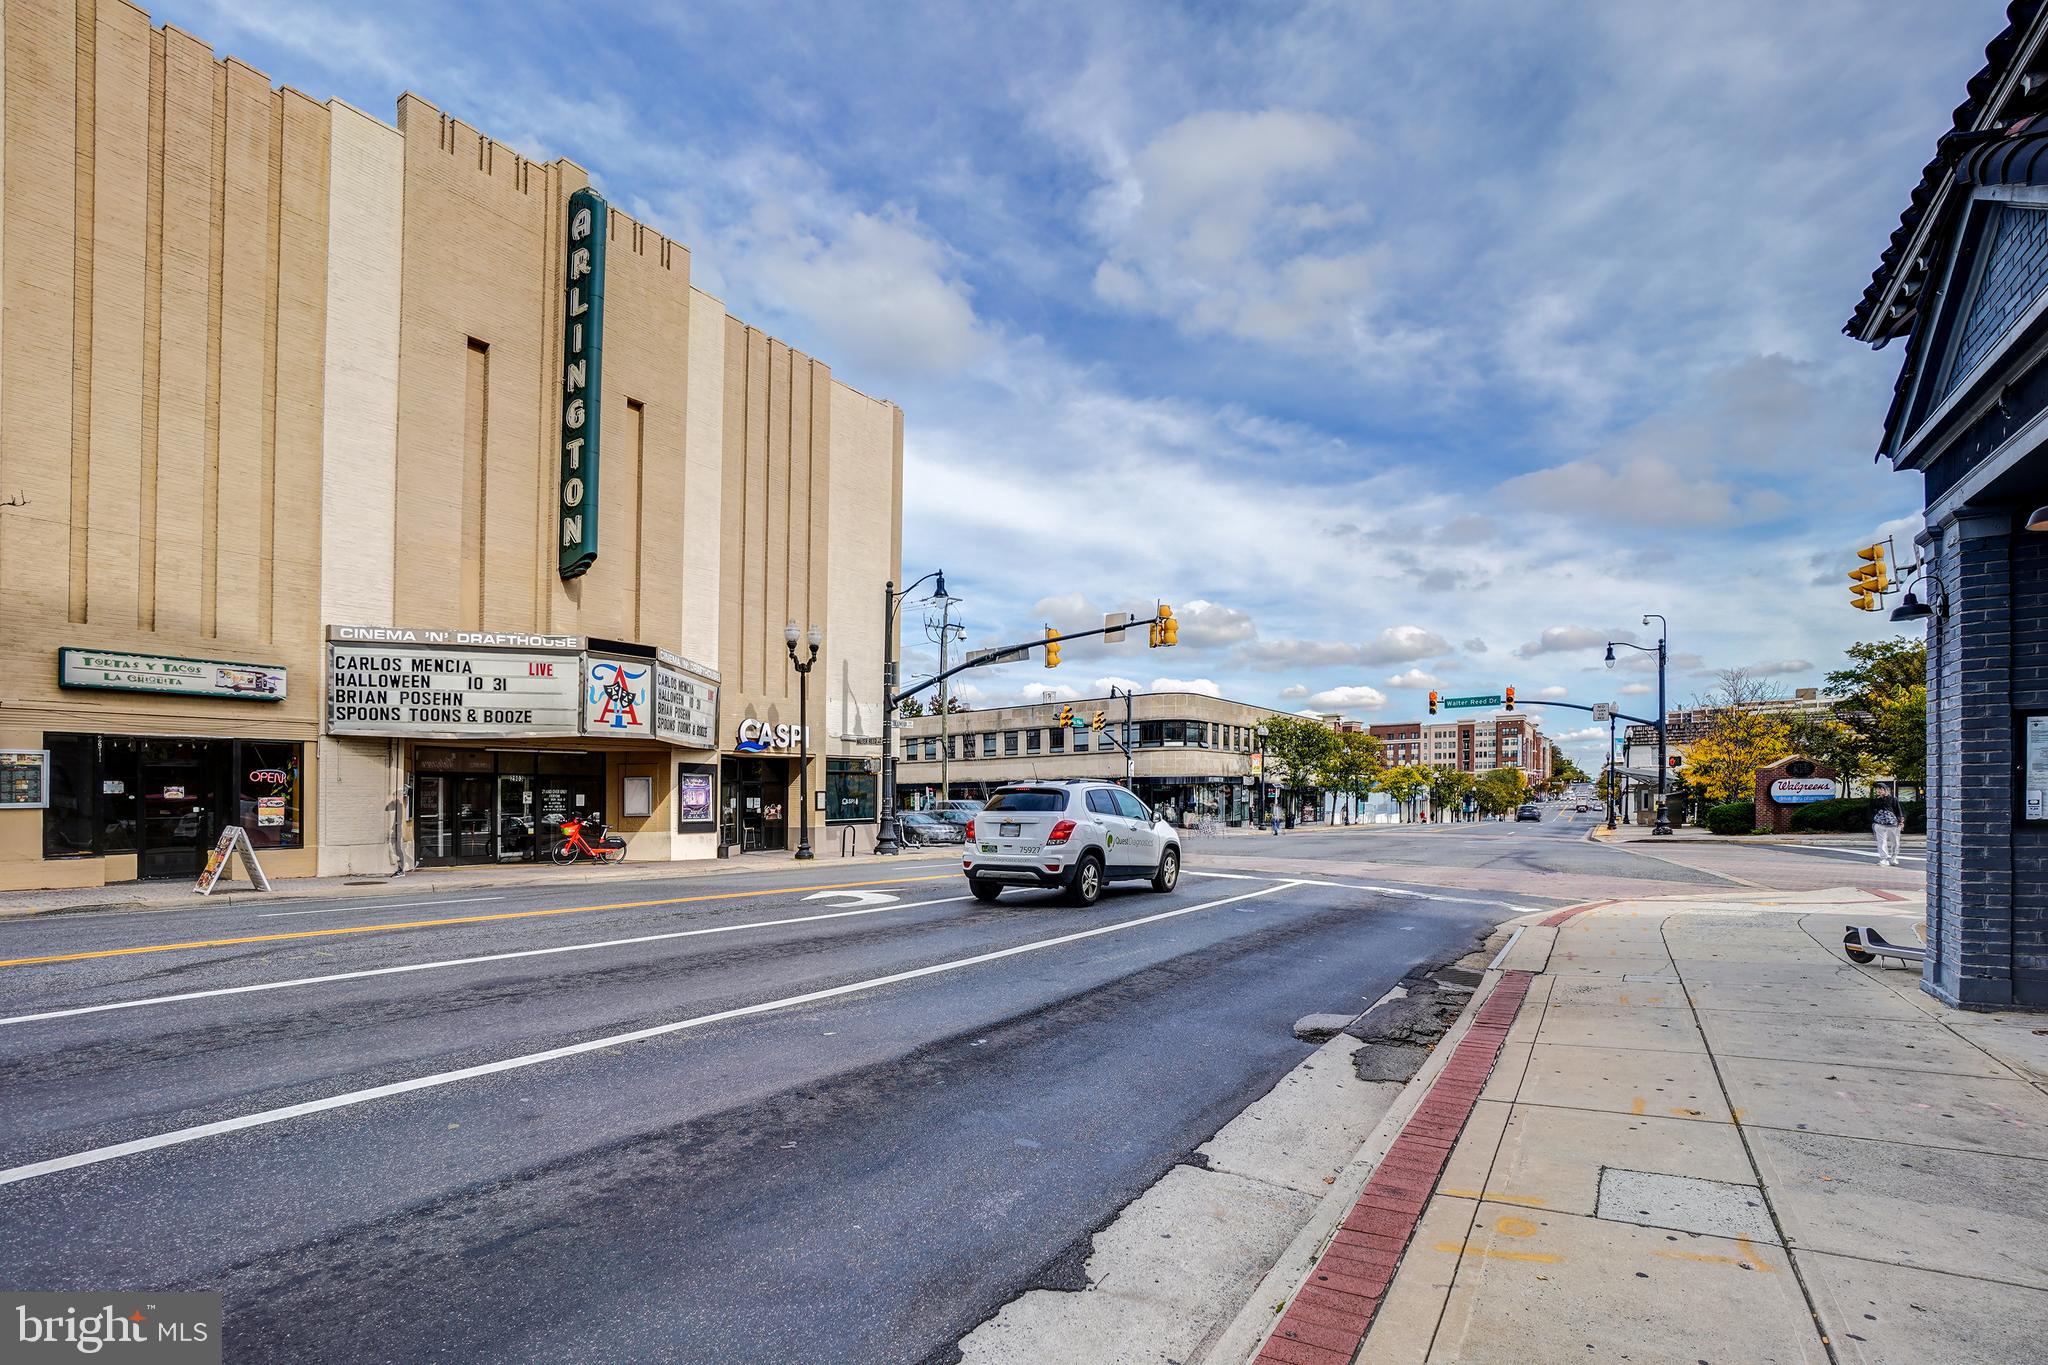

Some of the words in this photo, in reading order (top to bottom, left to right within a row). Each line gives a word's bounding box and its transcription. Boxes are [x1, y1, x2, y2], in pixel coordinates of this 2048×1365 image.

[563, 207, 592, 548] ARLINGTON
[340, 628, 416, 641] CINEMA
[457, 633, 577, 647] DRAFTHOUSE
[145, 663, 157, 671] Y
[335, 656, 402, 672] CARLOS
[411, 658, 472, 674] MENCIA
[529, 662, 553, 677] LIVE
[335, 673, 430, 689] HALLOWEEN
[493, 677, 507, 691] 31
[657, 673, 677, 690] CARLOS
[678, 680, 694, 696] MENCIA
[335, 689, 387, 704] BRIAN
[400, 691, 463, 706] POSEHN
[657, 688, 684, 706] HALLOWEEN
[336, 706, 401, 721] SPOONS
[409, 708, 461, 723] TOONS
[467, 709, 478, 723] &
[484, 709, 532, 724] BOOZE
[657, 702, 673, 717] BRIAN
[674, 706, 691, 721] POSEHN
[657, 717, 676, 732] SPOONS
[677, 721, 691, 735] TOONS
[738, 718, 809, 748] CASPI
[250, 771, 284, 783] OPEN
[1777, 781, 1830, 794] Walgreens
[1020, 846, 1040, 854] 75927
